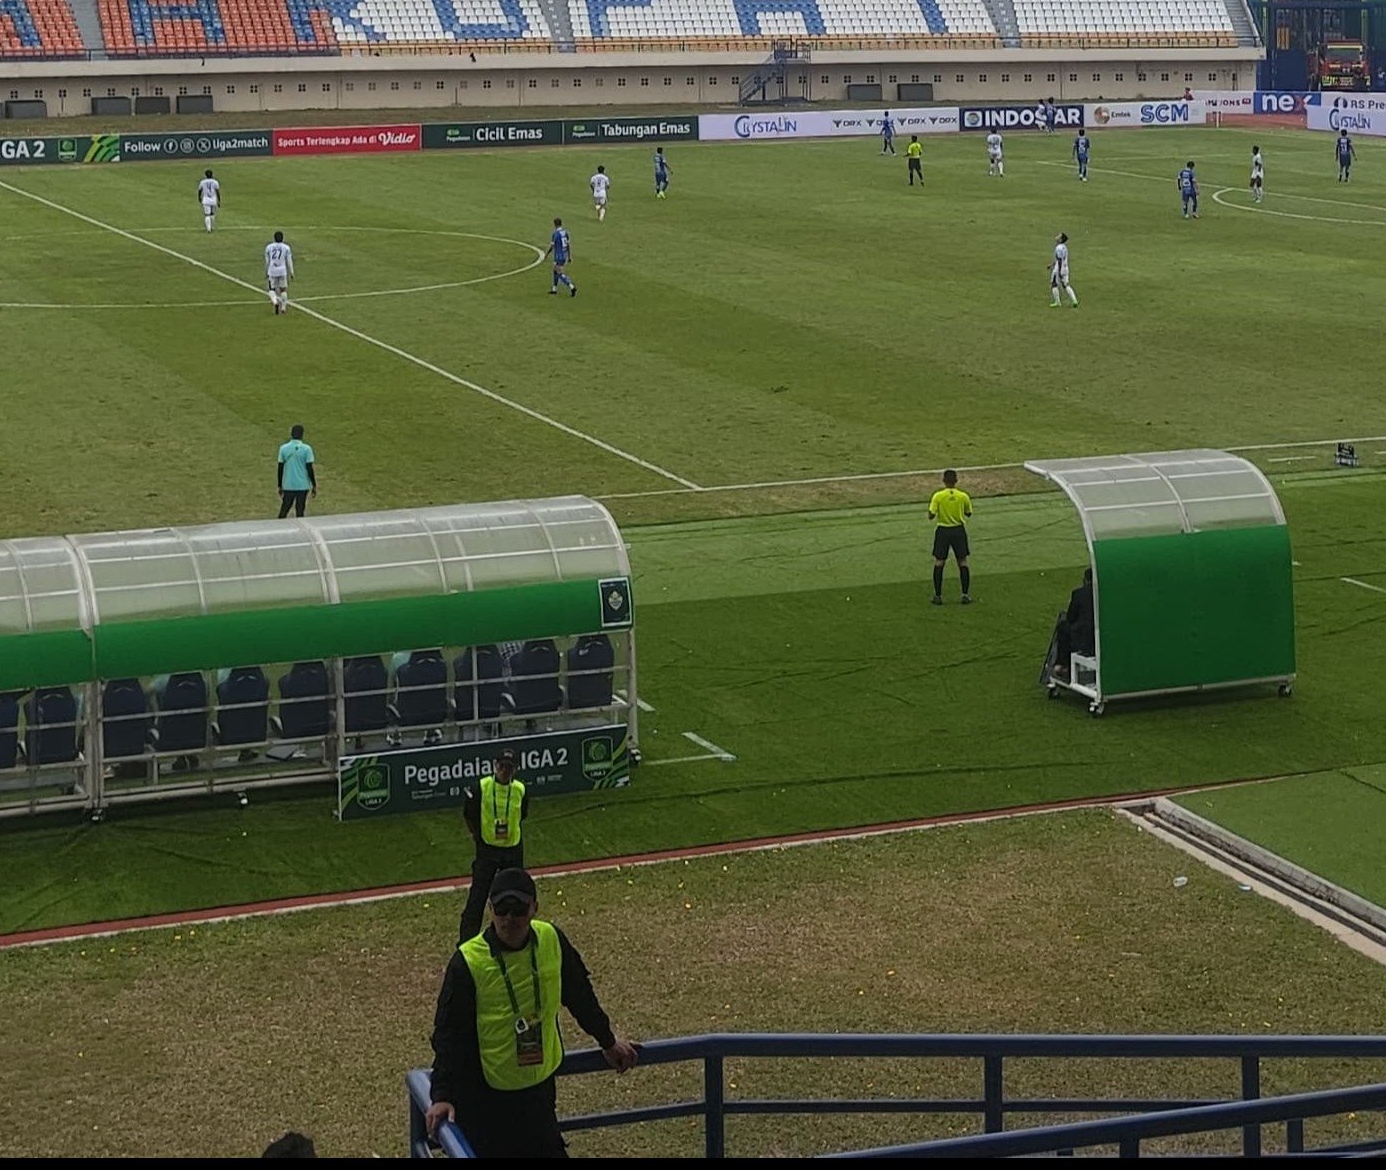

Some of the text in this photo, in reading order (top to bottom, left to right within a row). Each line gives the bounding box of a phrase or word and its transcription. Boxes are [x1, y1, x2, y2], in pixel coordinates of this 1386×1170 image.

[1350, 99, 1364, 109] RS
[1140, 104, 1189, 123] SCM
[476, 127, 543, 142] Cicil Emas
[602, 122, 691, 139] Tabungan Emas
[124, 140, 161, 153] Follow
[277, 131, 416, 148] Sports Terlengkap Ada di Vidio
[33, 140, 45, 158] 2
[557, 747, 568, 766] 2
